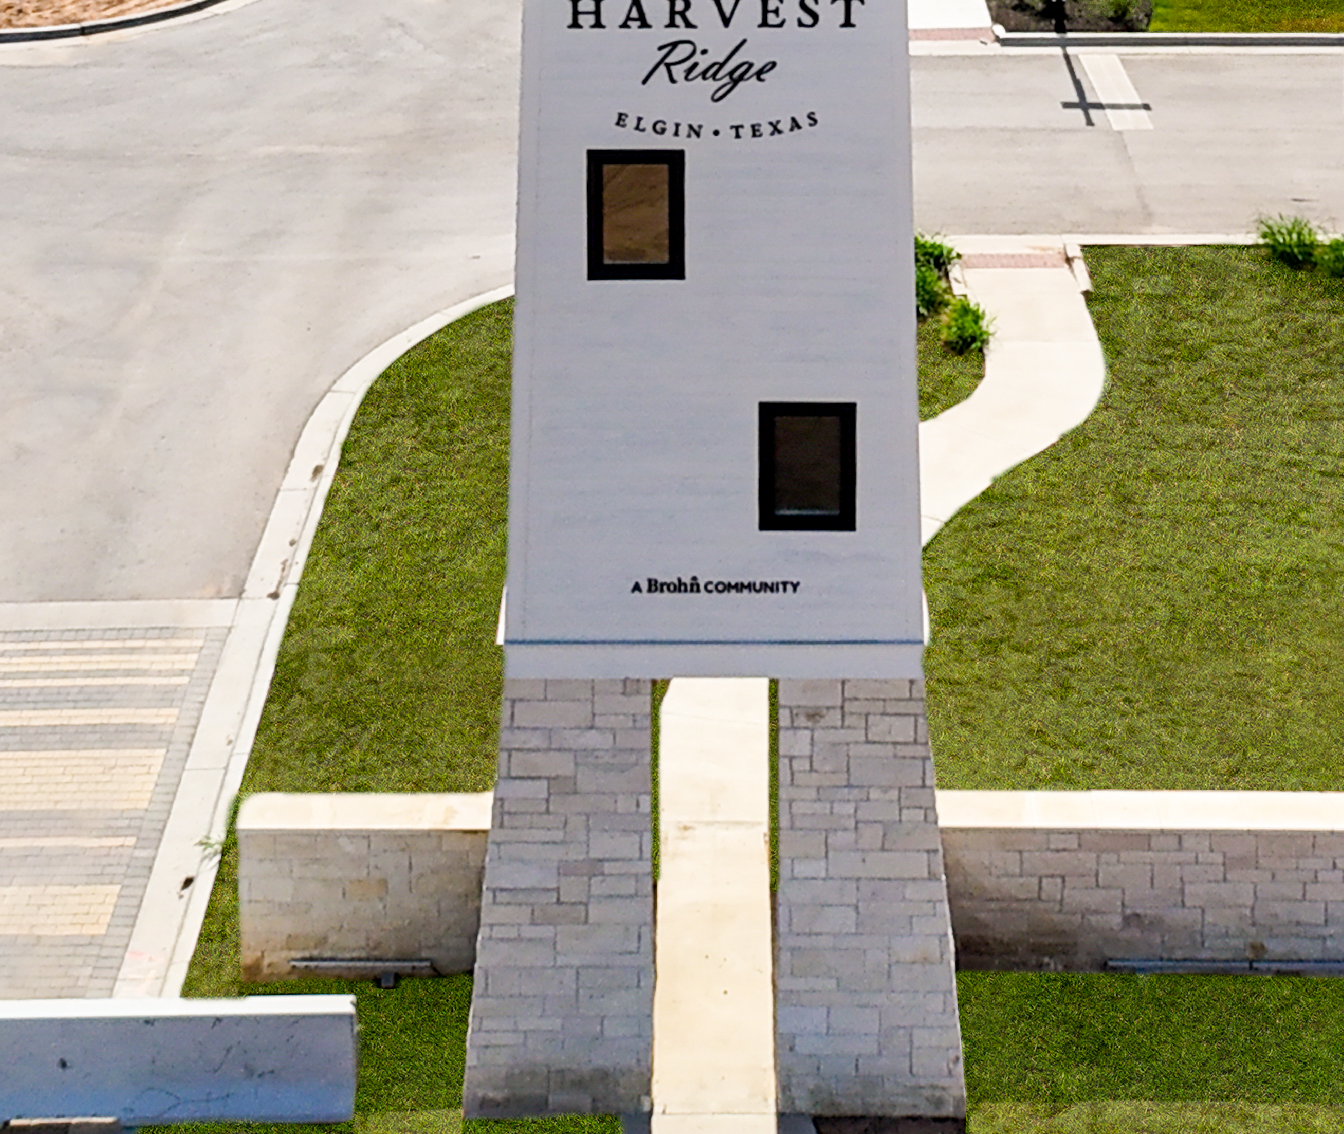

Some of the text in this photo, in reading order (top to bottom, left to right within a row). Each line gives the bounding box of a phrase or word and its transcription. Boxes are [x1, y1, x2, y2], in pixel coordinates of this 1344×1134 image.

[640, 38, 778, 104] Ridge
[614, 111, 819, 140] ELGIN TEXAS
[630, 575, 801, 595] A Brohn COMMUNITY
